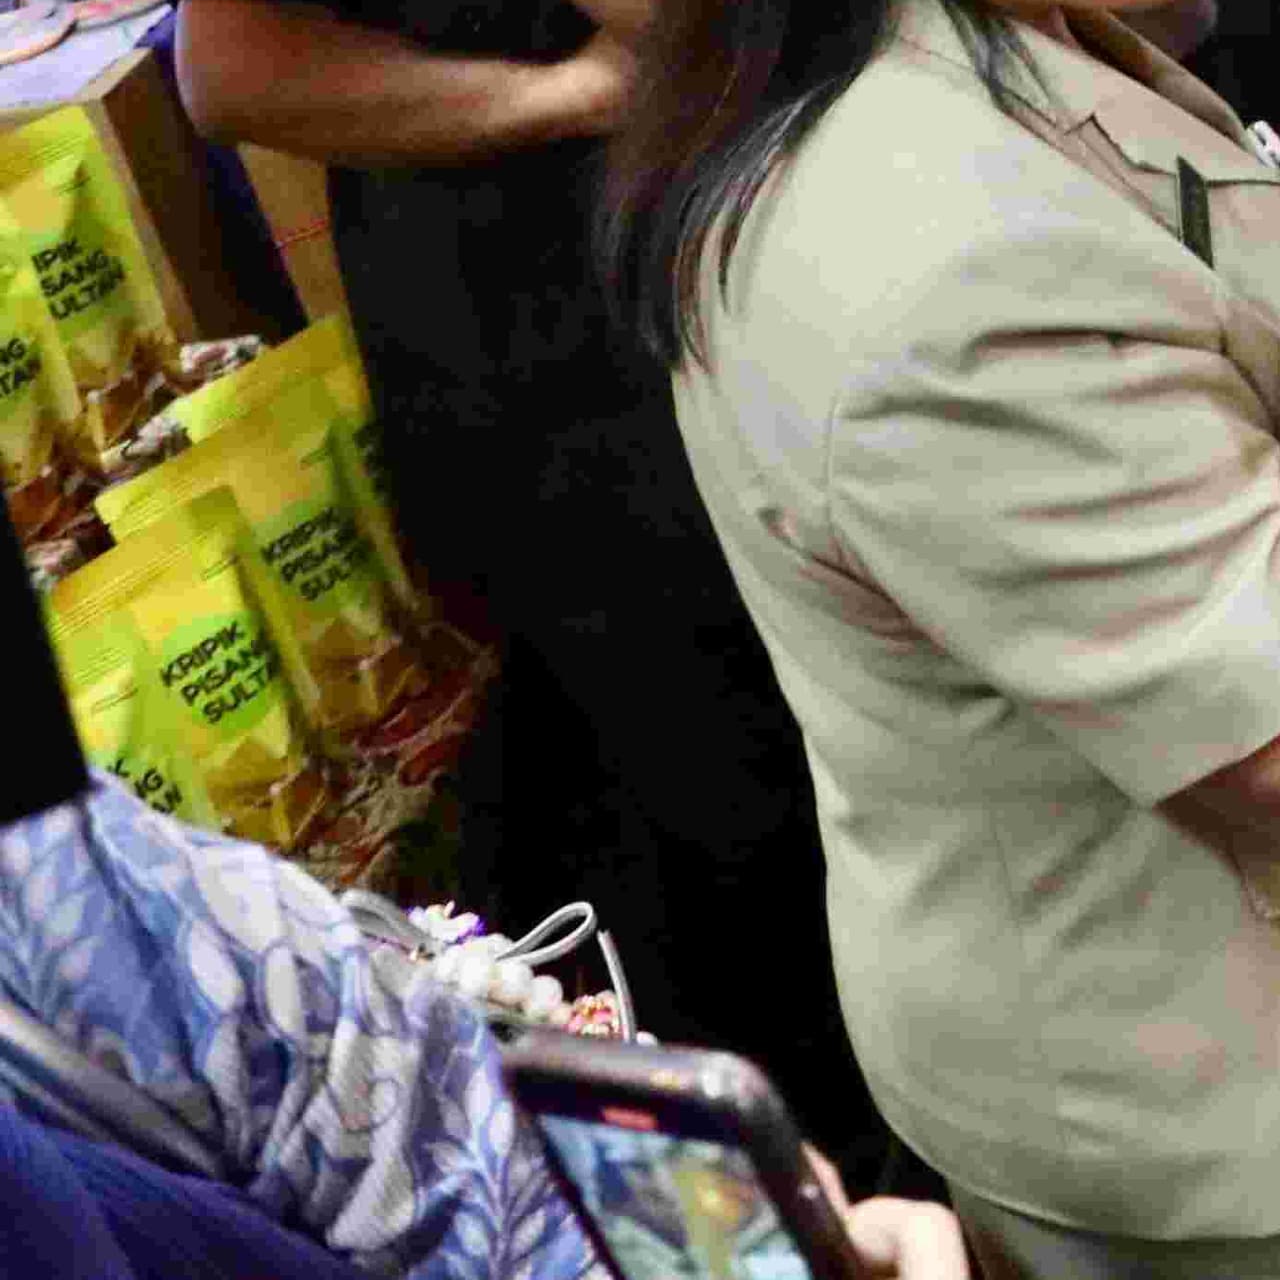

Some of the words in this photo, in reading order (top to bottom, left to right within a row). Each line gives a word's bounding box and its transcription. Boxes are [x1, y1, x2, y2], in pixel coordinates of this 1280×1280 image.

[261, 506, 340, 565] KRIPIK
[160, 620, 247, 688] KRIPIK
[181, 642, 262, 707] PISAN
